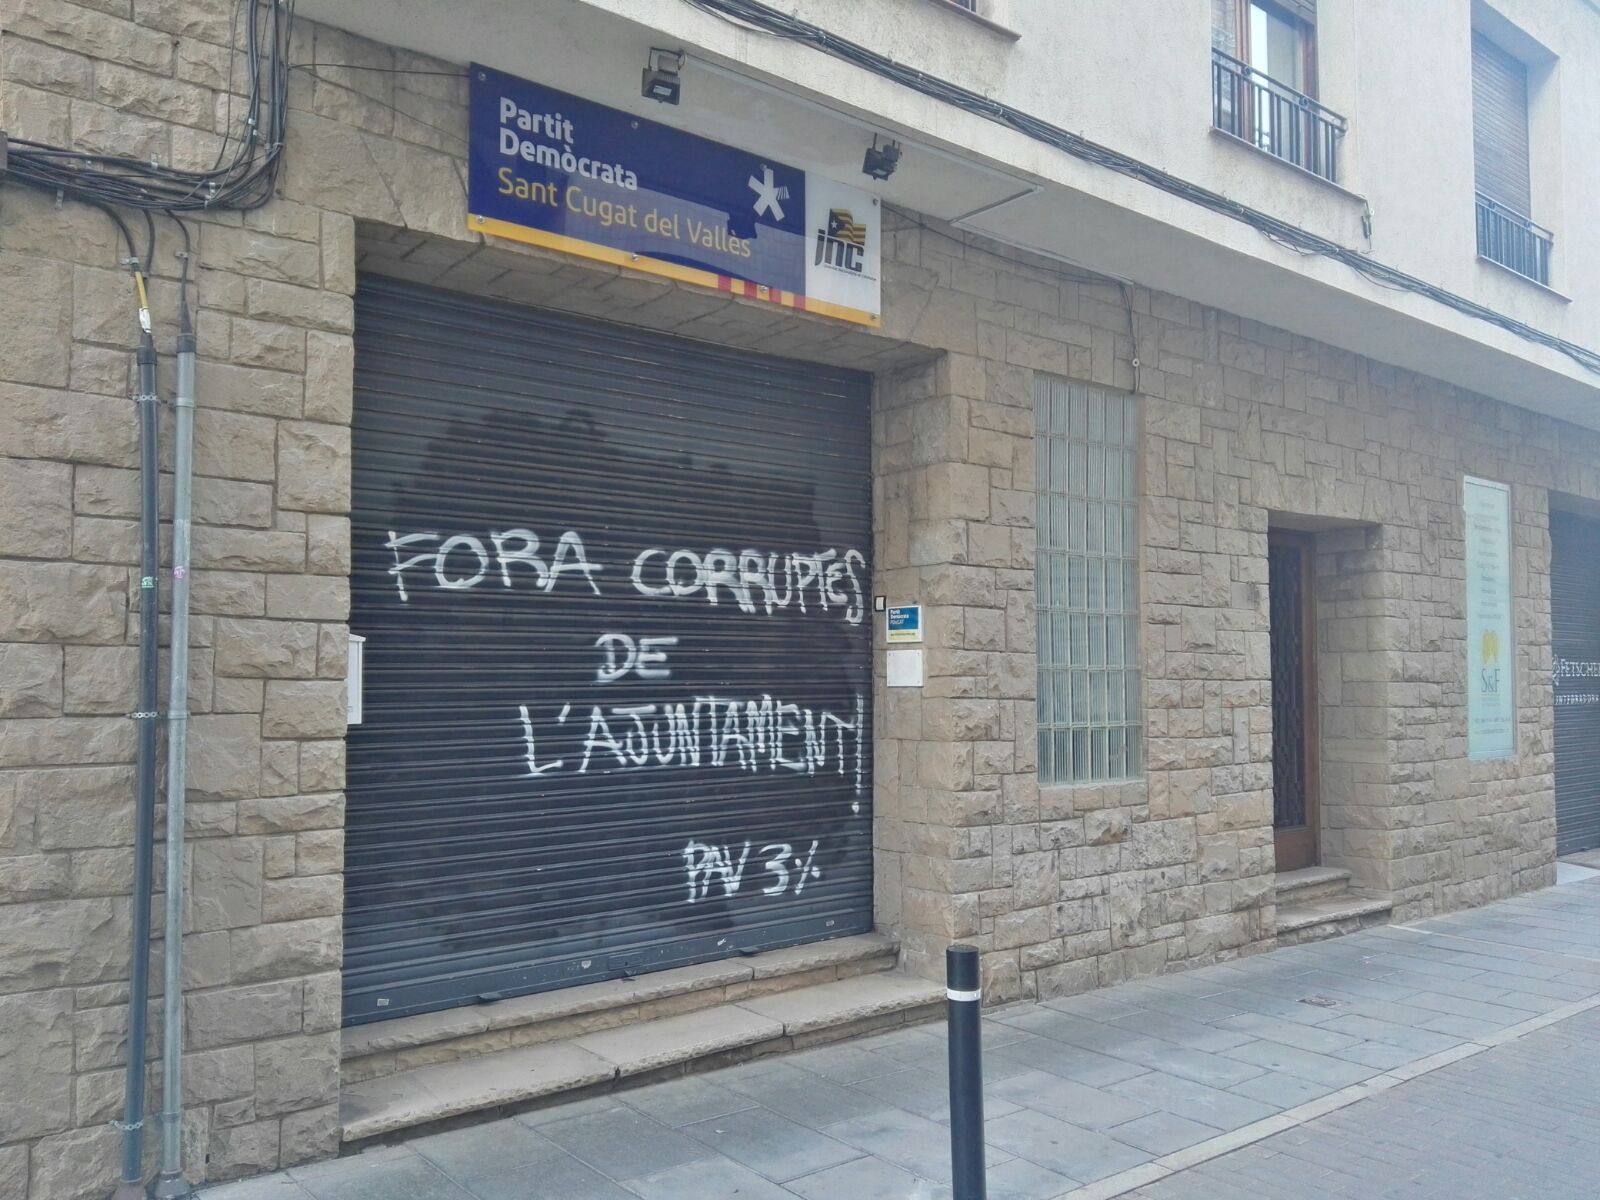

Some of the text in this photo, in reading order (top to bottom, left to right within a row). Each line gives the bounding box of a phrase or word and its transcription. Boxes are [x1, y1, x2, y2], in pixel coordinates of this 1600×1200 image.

[499, 96, 574, 144] Partit
[499, 126, 638, 191] Demòcrata
[498, 166, 751, 258] Sant Cugat del Vallès
[384, 529, 866, 626] FORA CORRUPTES
[593, 633, 679, 682] DE
[1560, 658, 1600, 677] FETSCHE
